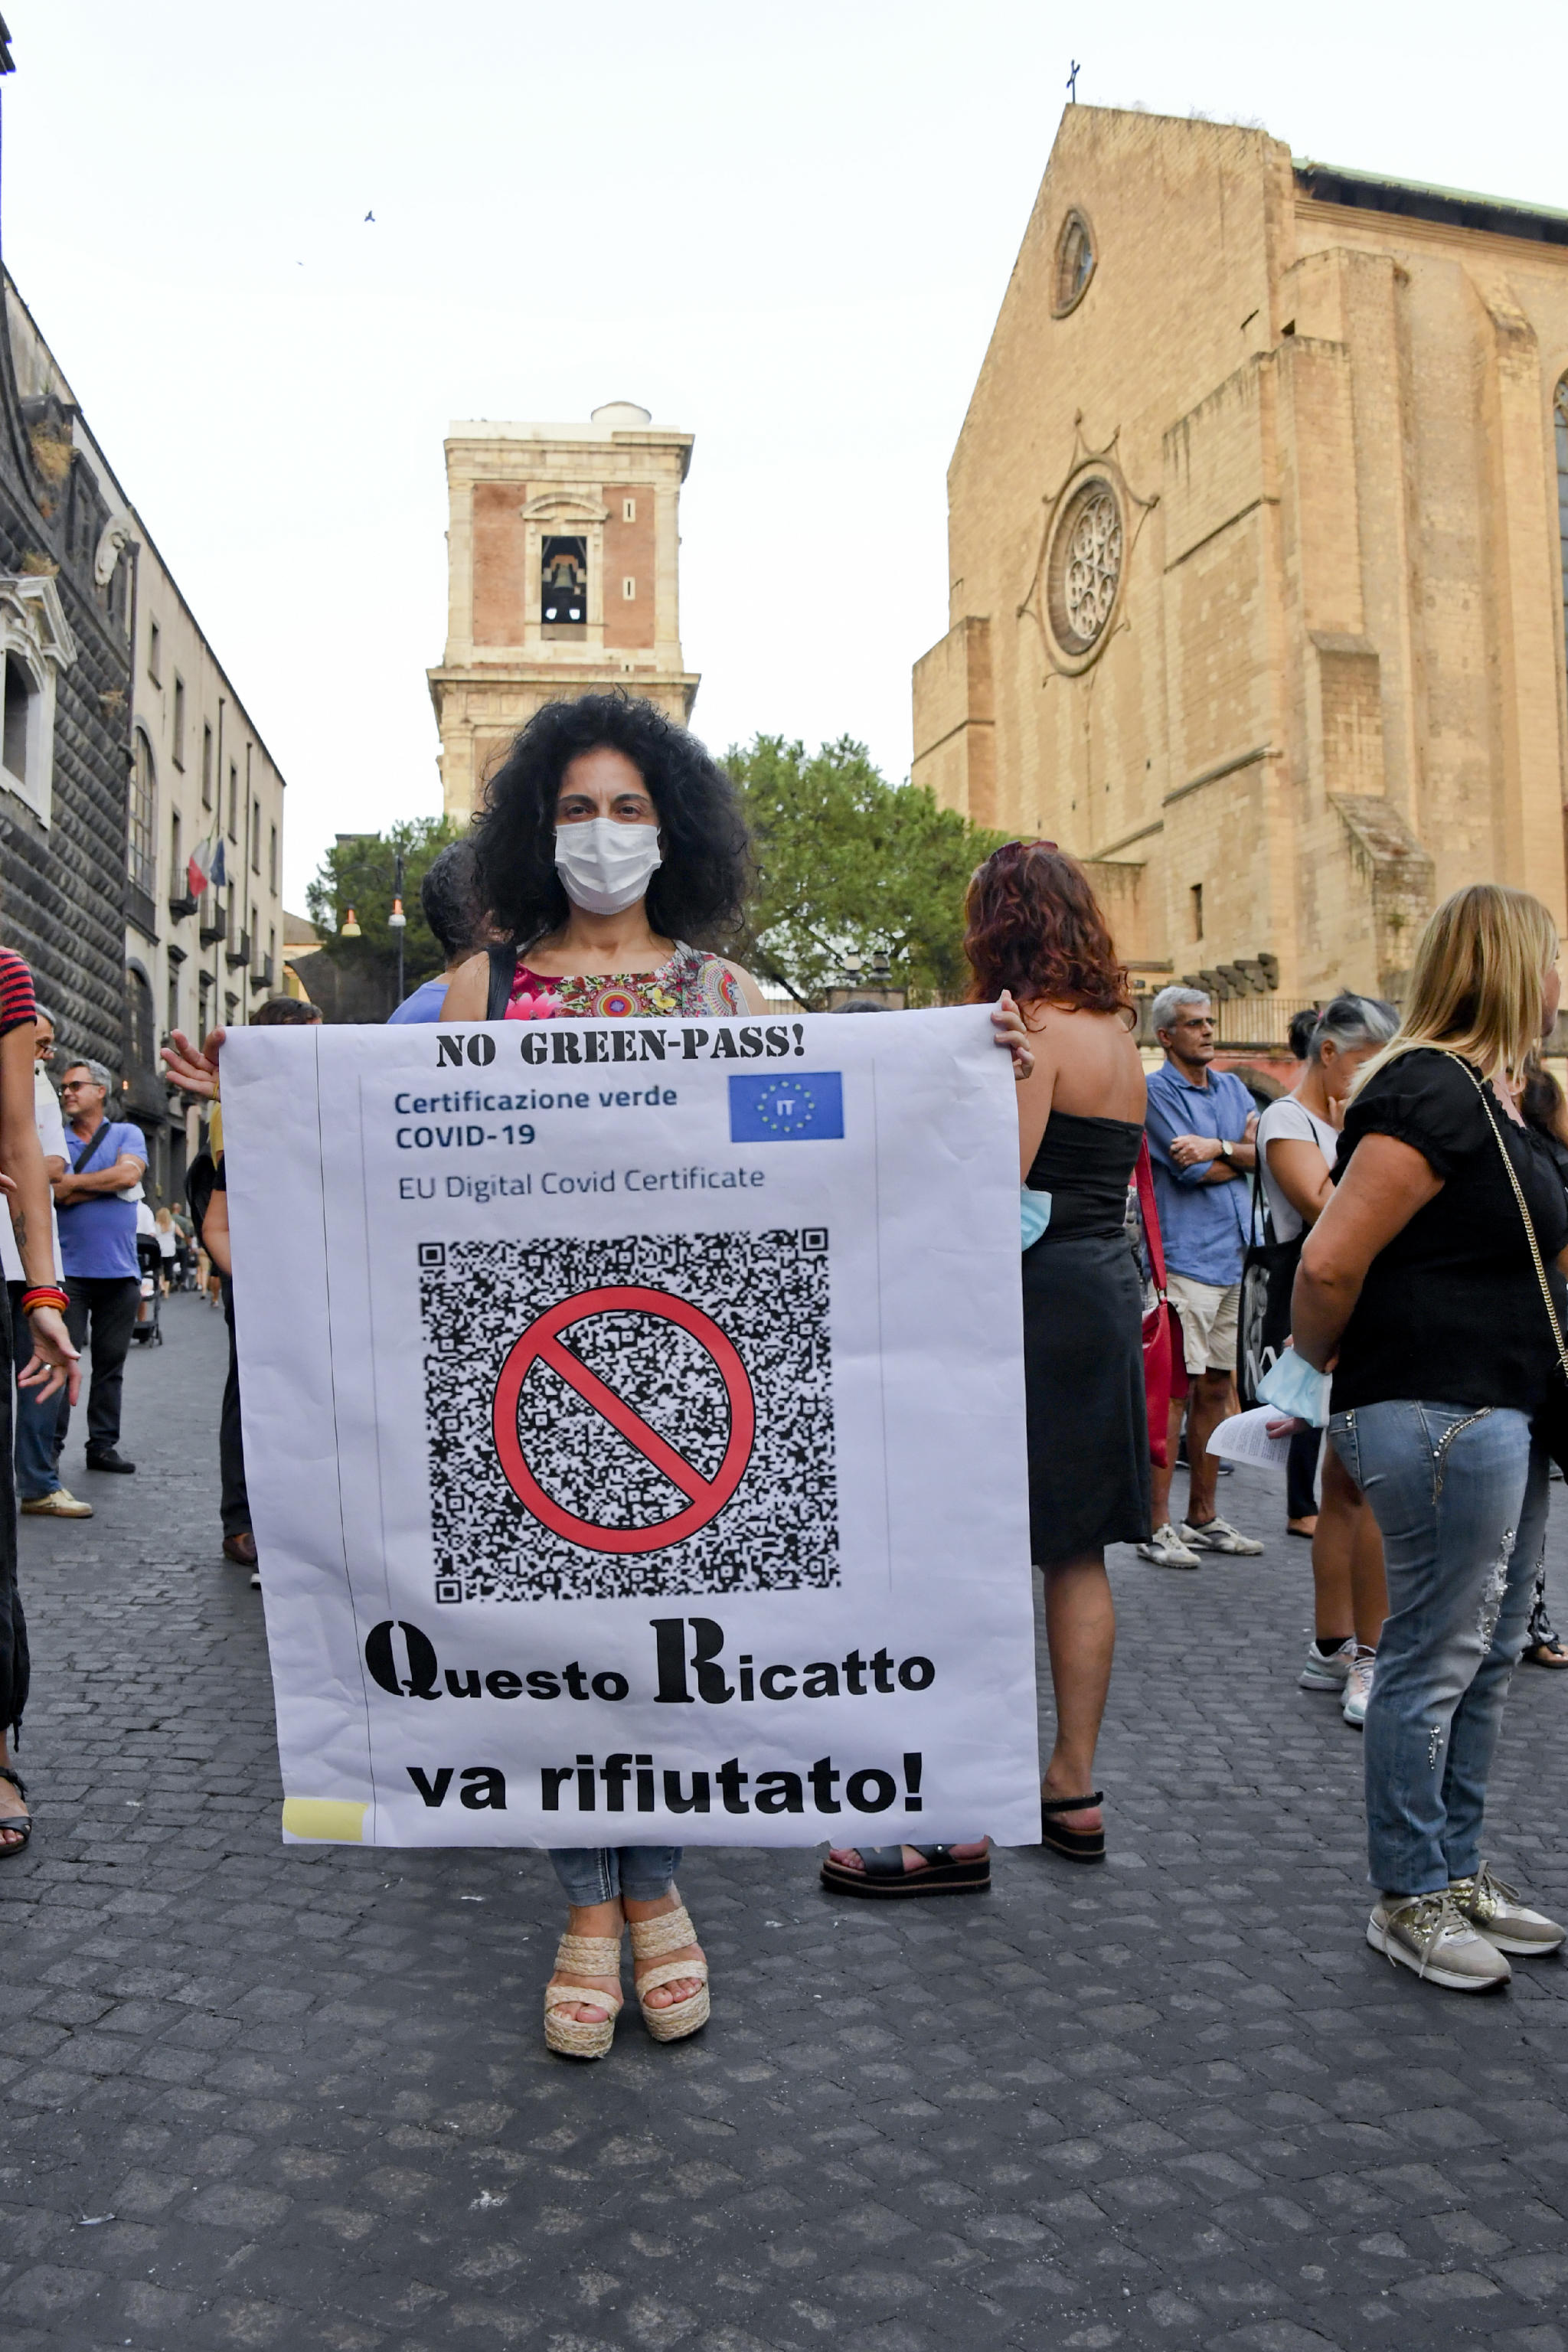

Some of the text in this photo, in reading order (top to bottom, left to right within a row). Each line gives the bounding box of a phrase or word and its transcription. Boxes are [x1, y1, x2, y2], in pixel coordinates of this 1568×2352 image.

[436, 1023, 805, 1068] NO GREEN-PASS!
[394, 1083, 678, 1115] Certificazione verde
[776, 1099, 795, 1116] IT
[395, 1123, 536, 1149] COVID-19
[398, 1165, 766, 1203] EU Digital Covid Certificate
[364, 1617, 936, 1704] Questo Ricatto
[406, 1752, 923, 1814] va rifiutato!
